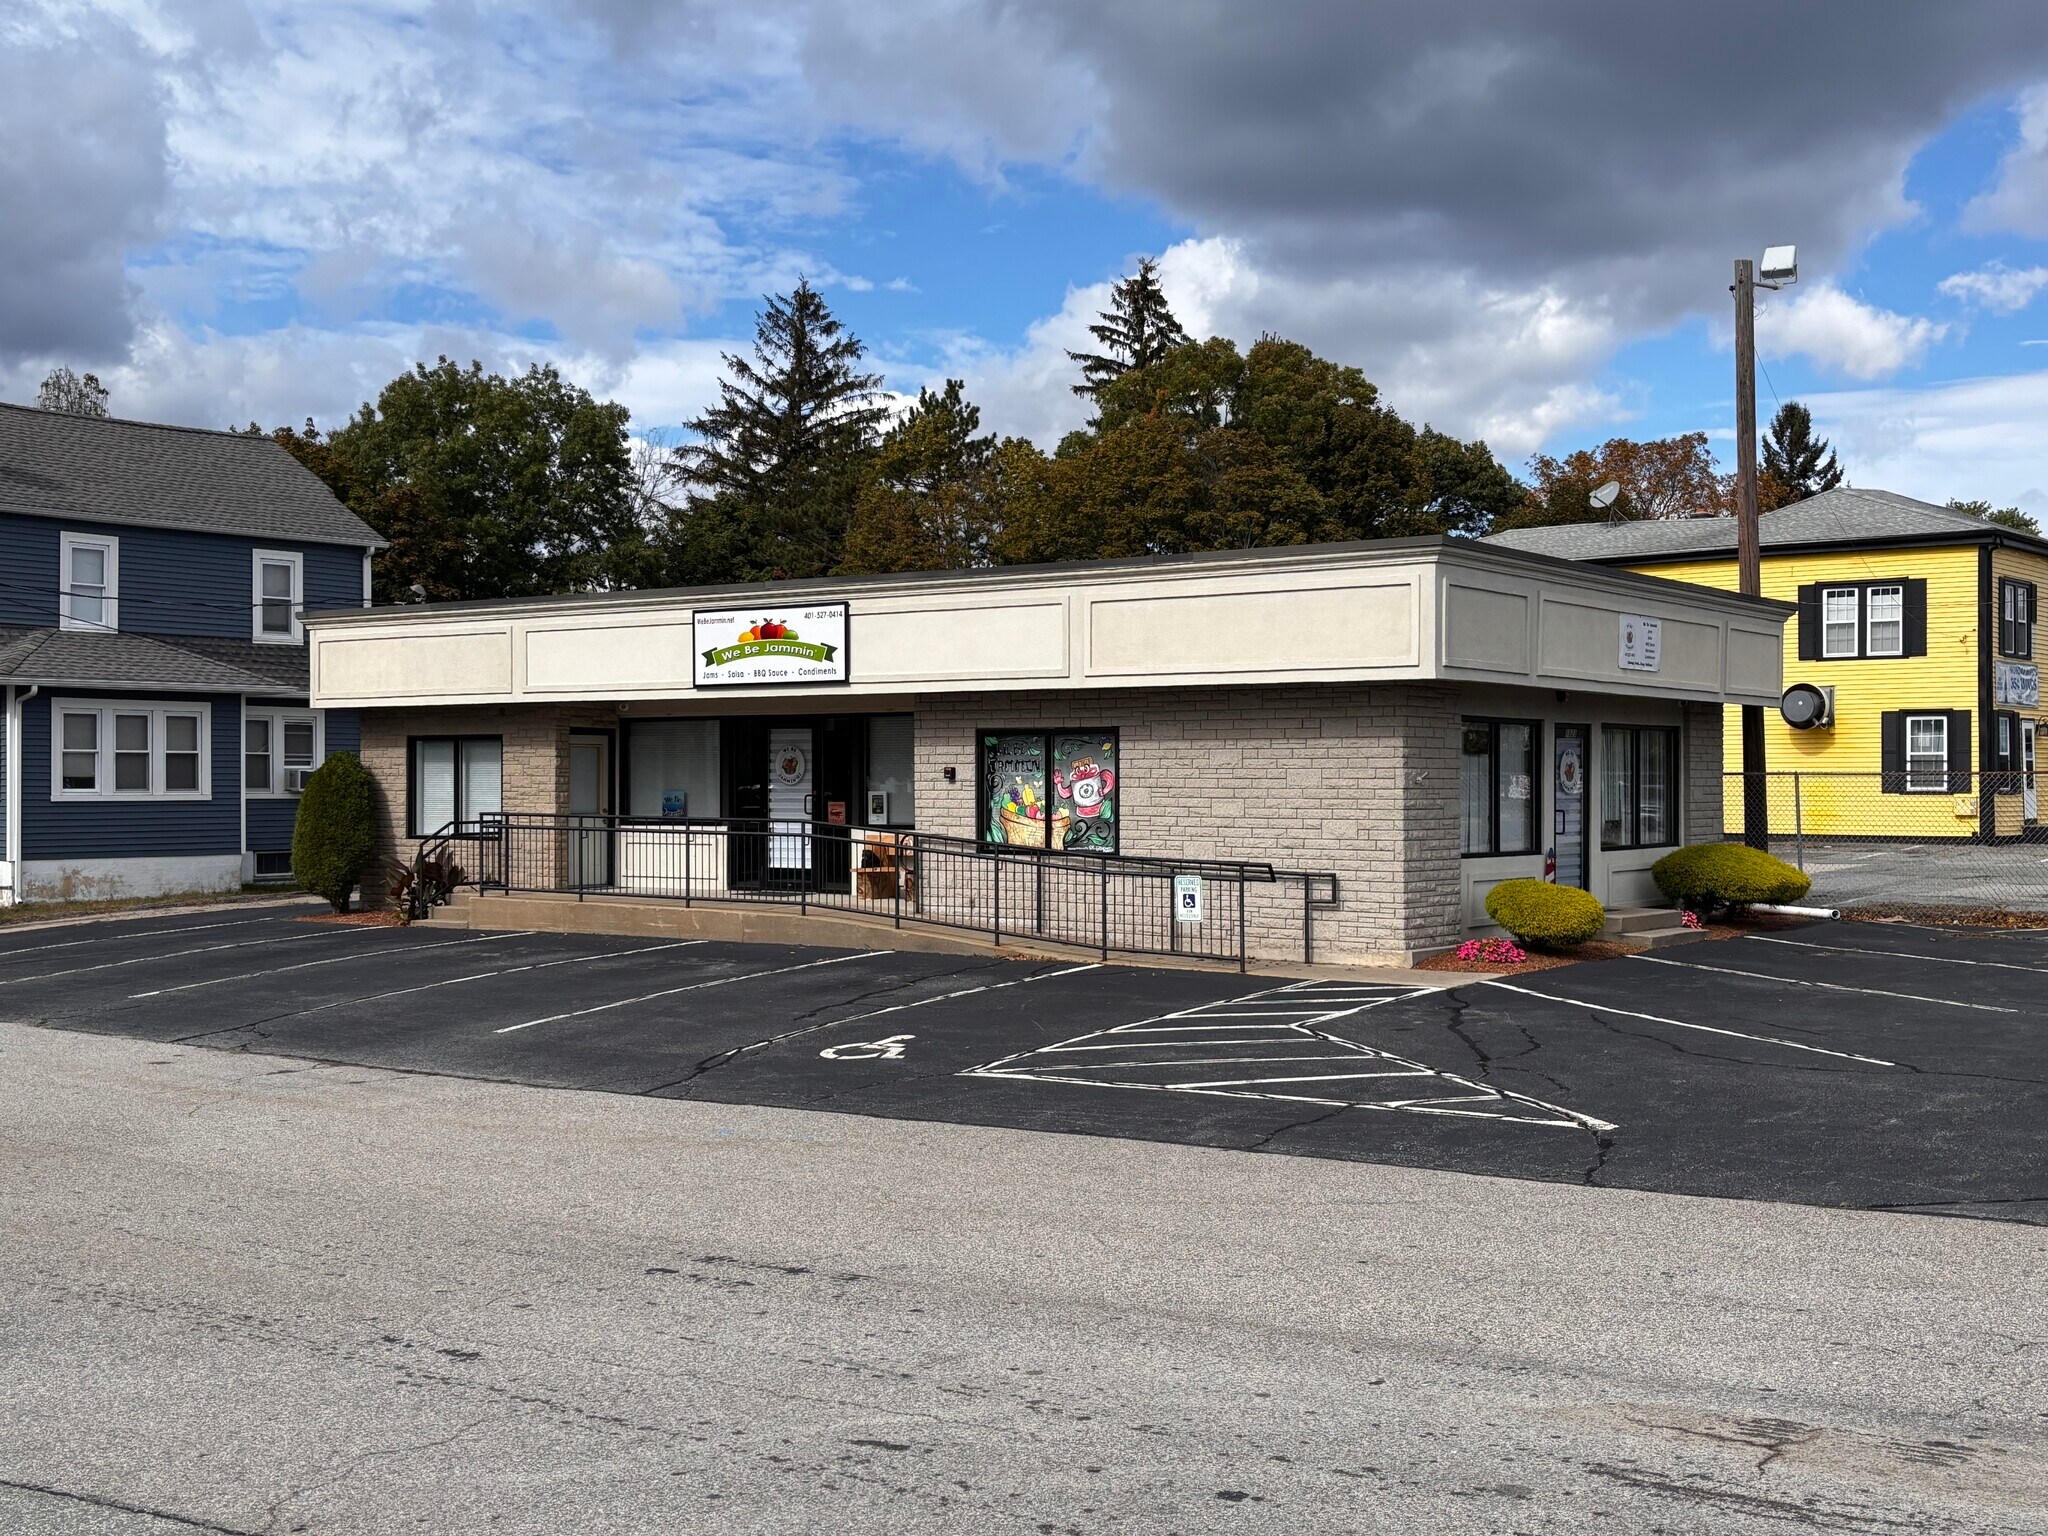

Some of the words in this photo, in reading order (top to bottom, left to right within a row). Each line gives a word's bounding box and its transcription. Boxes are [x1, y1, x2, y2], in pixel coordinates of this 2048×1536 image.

[804, 610, 843, 619] 401-527-0414
[697, 616, 734, 625] WeBeJammin.net
[721, 649, 740, 660] We
[744, 645, 760, 655] Be
[764, 643, 818, 657] Jammin'
[727, 670, 745, 678] Salsa
[753, 669, 766, 677] BBQ
[768, 668, 788, 677] Sauce
[798, 667, 837, 676] Condiments
